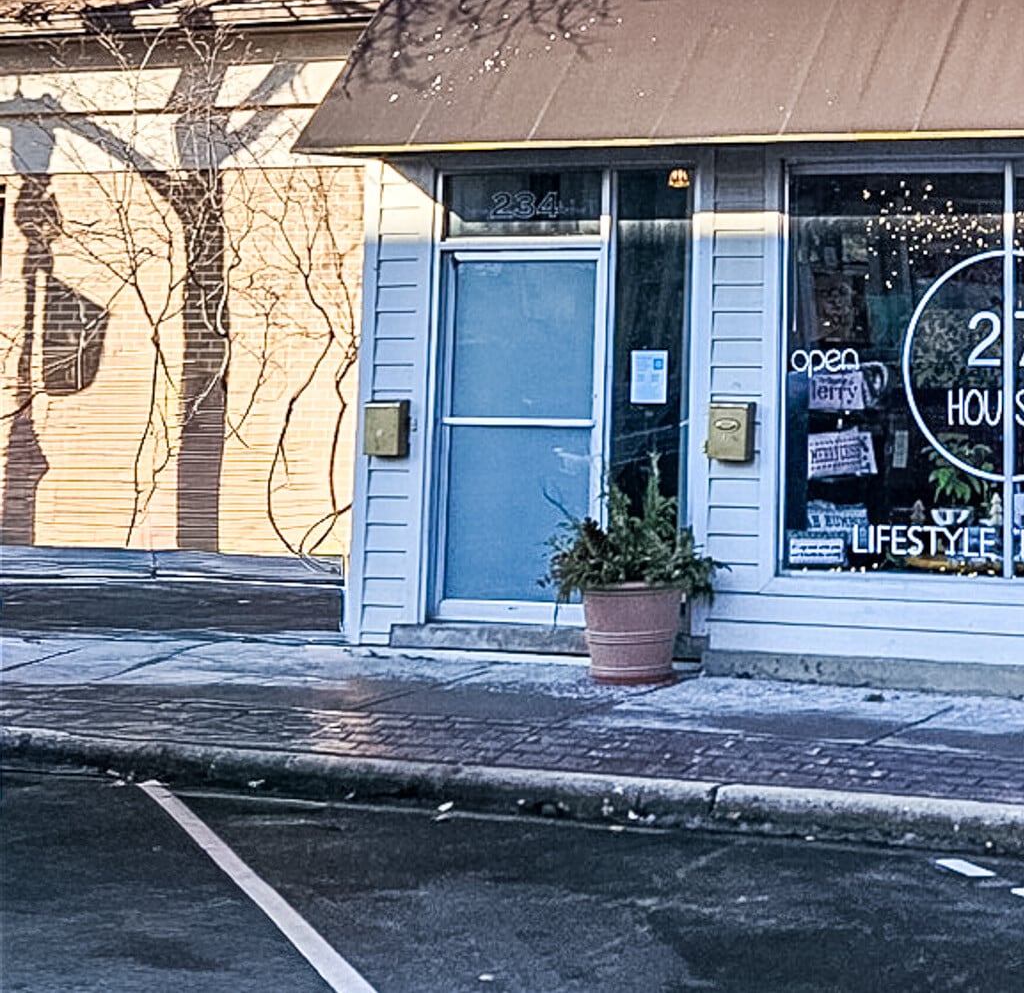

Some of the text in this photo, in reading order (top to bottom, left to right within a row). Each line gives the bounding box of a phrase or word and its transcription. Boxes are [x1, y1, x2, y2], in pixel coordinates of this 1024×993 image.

[488, 191, 558, 219] 234
[791, 348, 860, 378] open
[851, 523, 996, 557] LIFESTYLE
